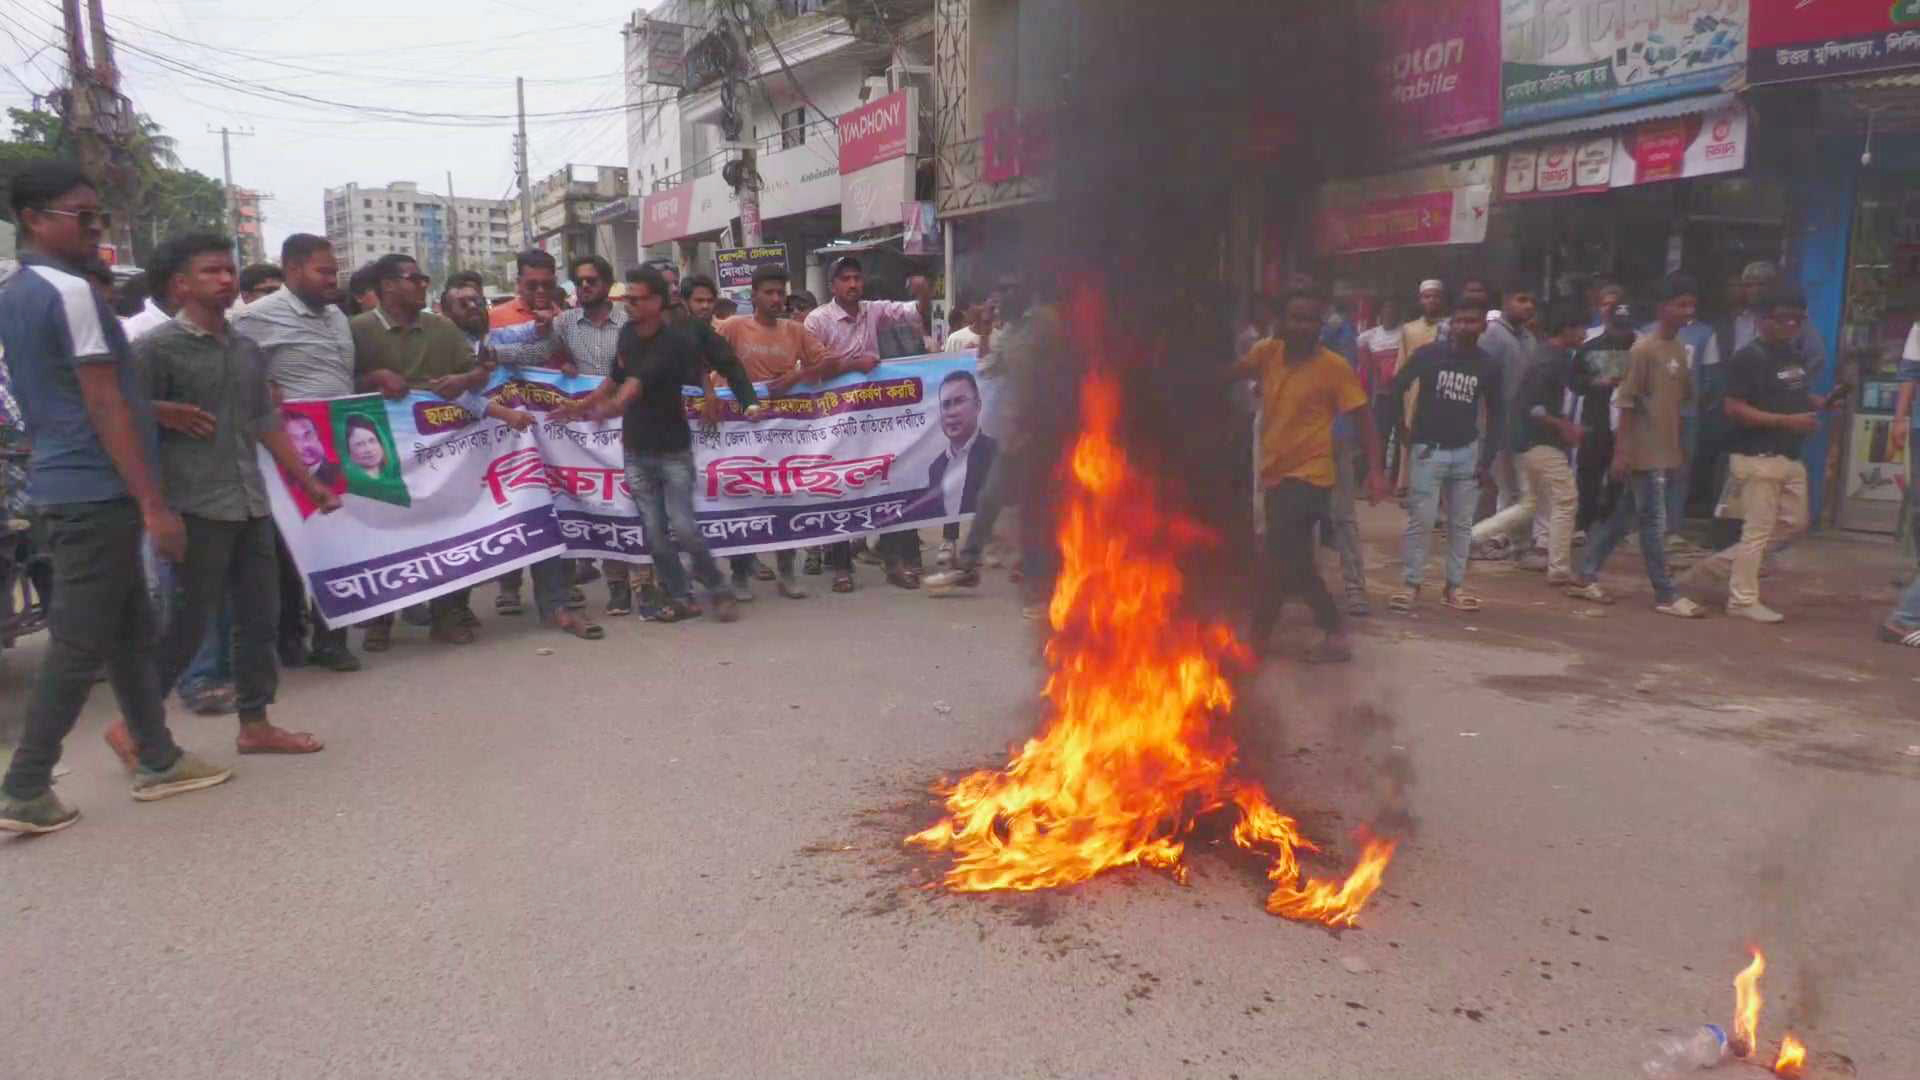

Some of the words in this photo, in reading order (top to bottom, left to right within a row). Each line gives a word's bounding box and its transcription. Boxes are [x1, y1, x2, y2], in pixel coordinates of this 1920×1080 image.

[838, 101, 901, 146] SYMPHONY
[704, 453, 896, 501] মিছিল
[560, 518, 645, 552] জপুর
[695, 513, 777, 541] ত্রদল
